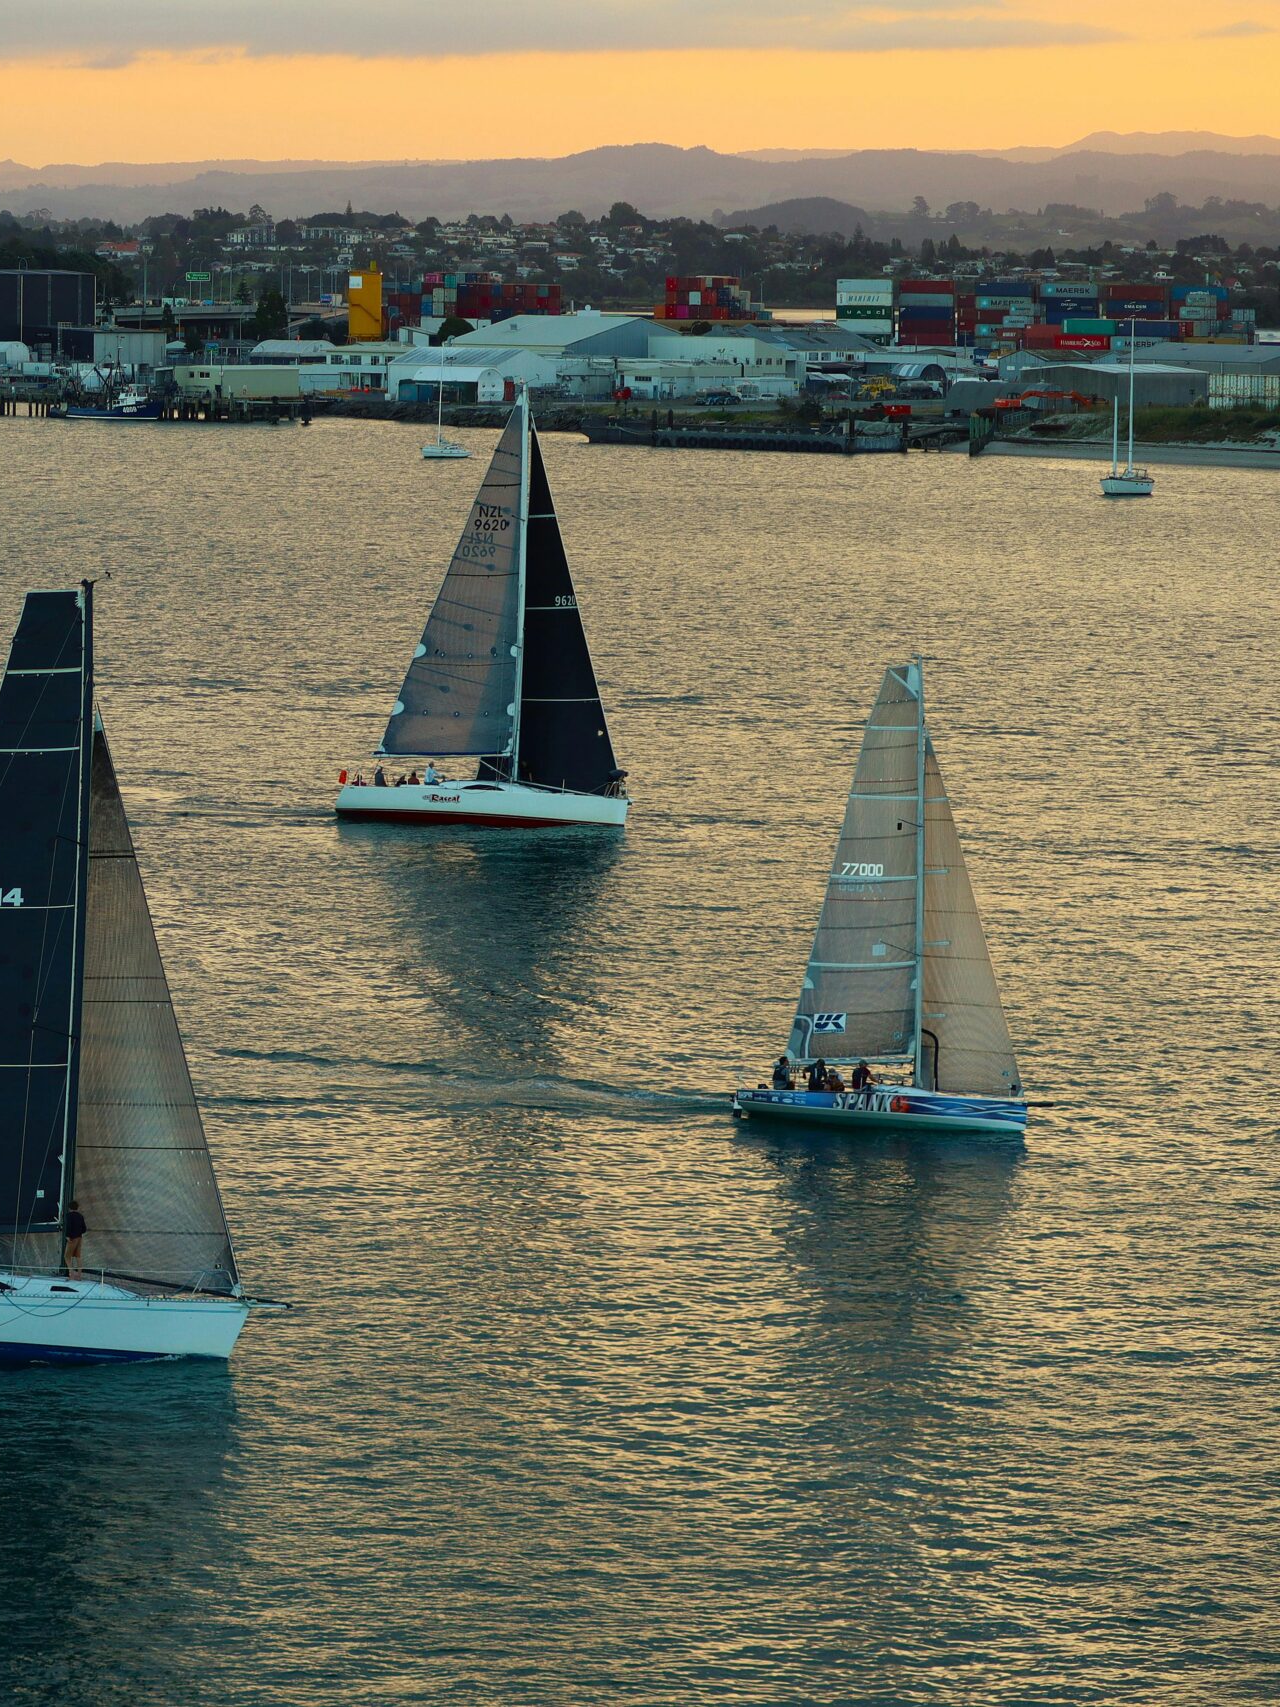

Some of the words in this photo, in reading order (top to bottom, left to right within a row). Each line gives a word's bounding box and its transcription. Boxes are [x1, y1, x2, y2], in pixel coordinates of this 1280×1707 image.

[479, 505, 503, 518] NZL
[474, 518, 507, 531] 9620
[554, 595, 576, 606] 9620
[431, 794, 460, 803] Rascal
[841, 862, 883, 876] 77000
[833, 1092, 894, 1112] SPANK
